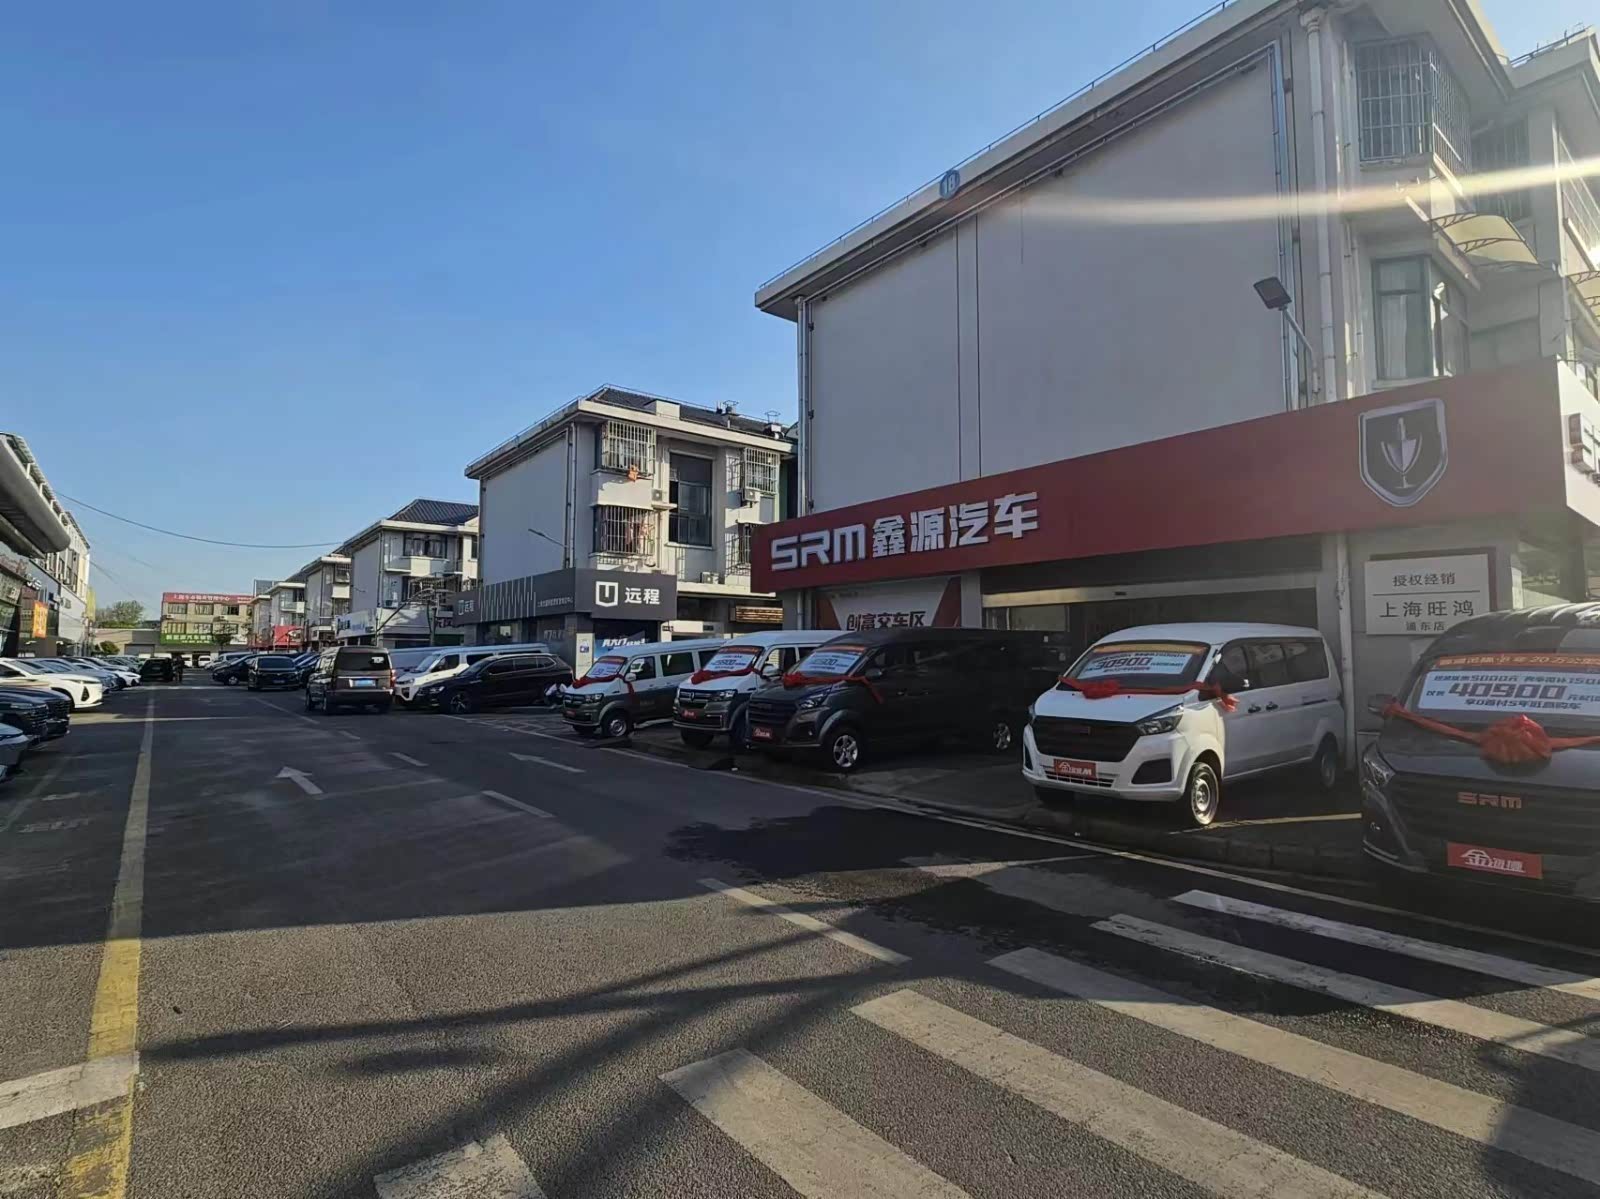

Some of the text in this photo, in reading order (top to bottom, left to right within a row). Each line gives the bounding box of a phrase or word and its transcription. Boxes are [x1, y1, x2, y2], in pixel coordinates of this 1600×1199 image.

[771, 491, 1039, 571] SRM 鑫源汽车
[1392, 572, 1456, 587] 授权经销
[624, 587, 660, 606] 远程
[1379, 600, 1474, 617] 上海旺鸿
[846, 611, 926, 632] 创富交车区
[1449, 682, 1568, 700] 40900
[1458, 791, 1523, 809] SRM
